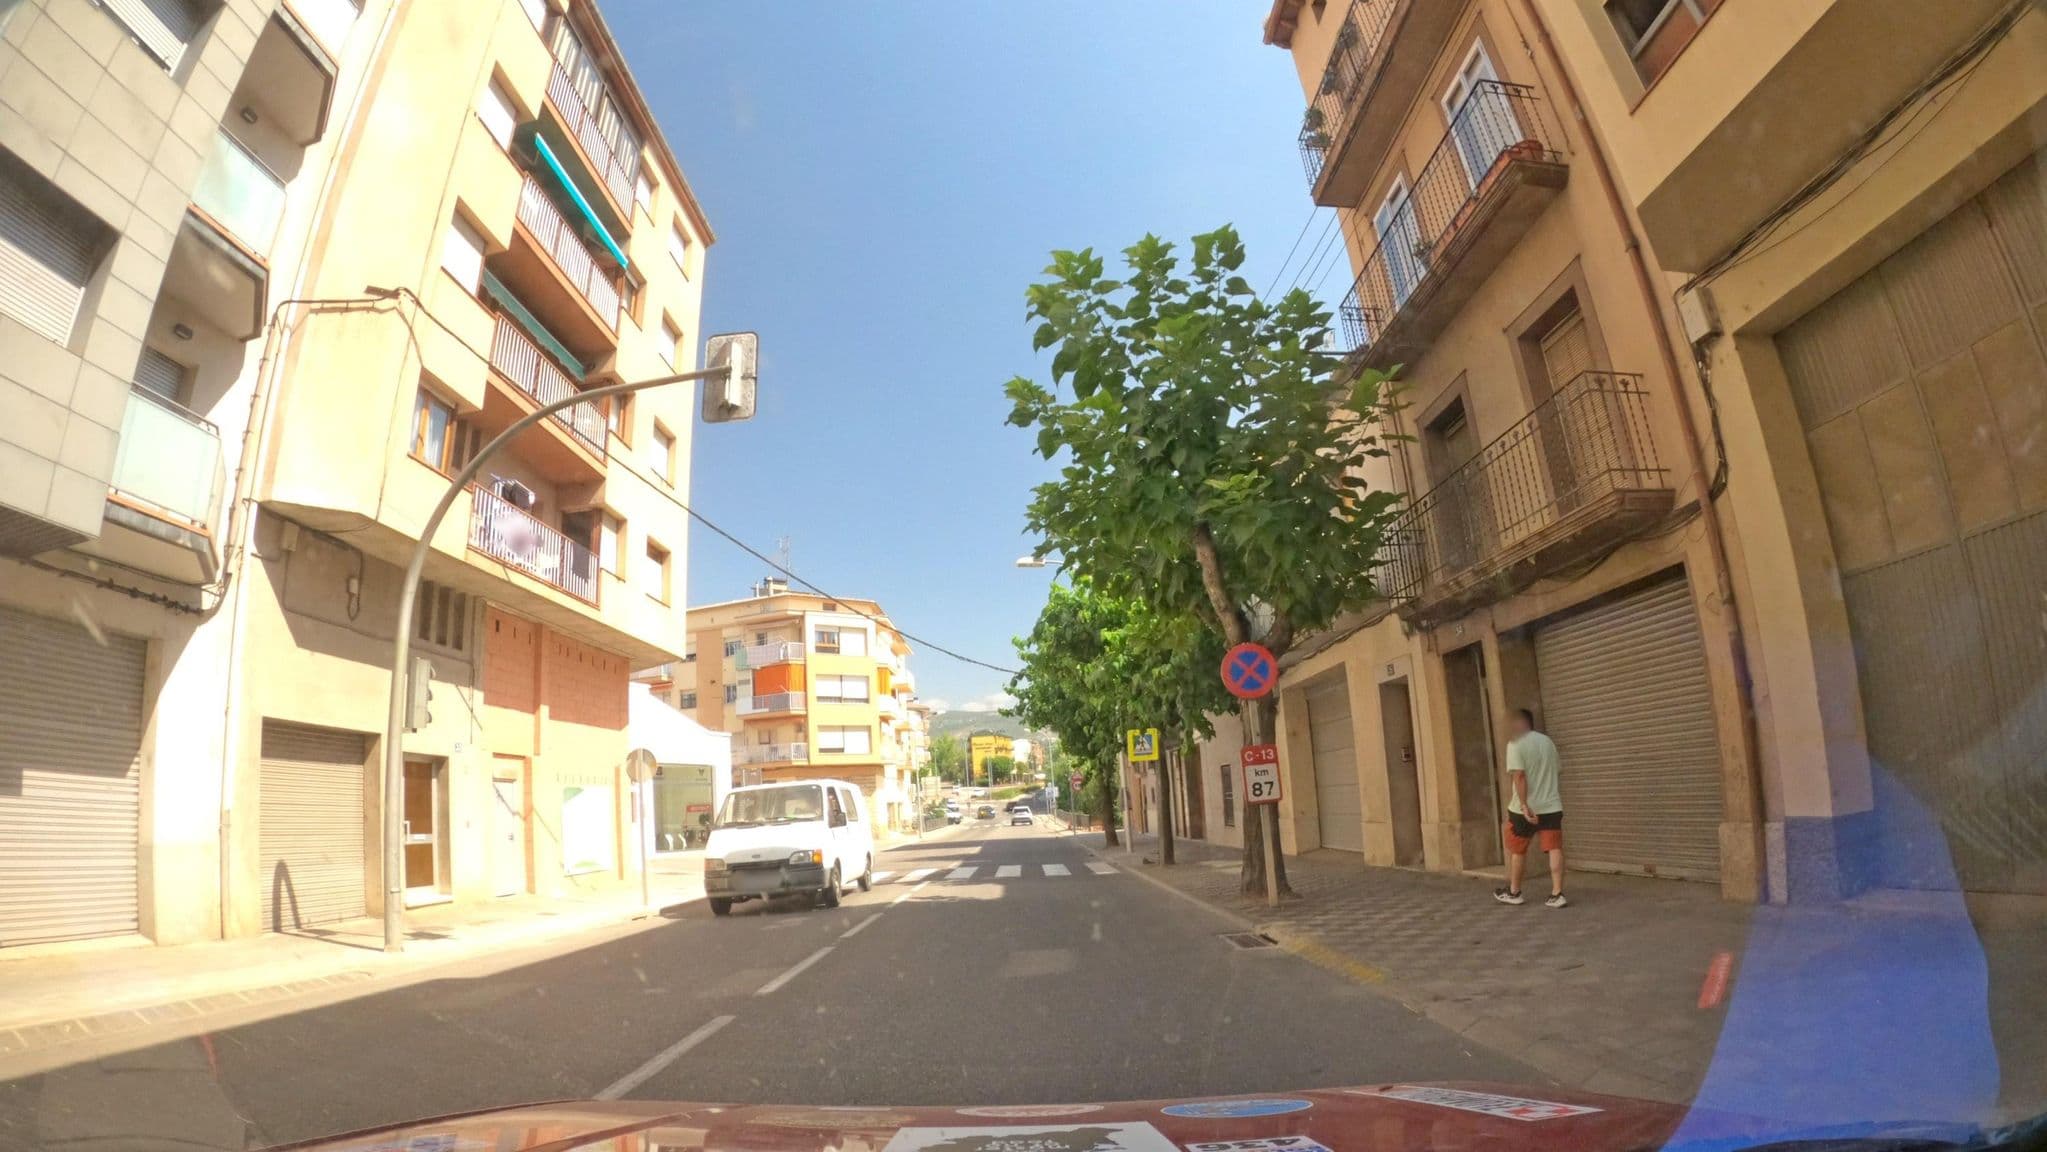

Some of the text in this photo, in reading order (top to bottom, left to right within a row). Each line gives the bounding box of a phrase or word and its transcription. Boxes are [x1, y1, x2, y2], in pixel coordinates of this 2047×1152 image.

[1244, 748, 1274, 762] C-13
[1254, 768, 1269, 777] km
[1252, 781, 1274, 797] 87
